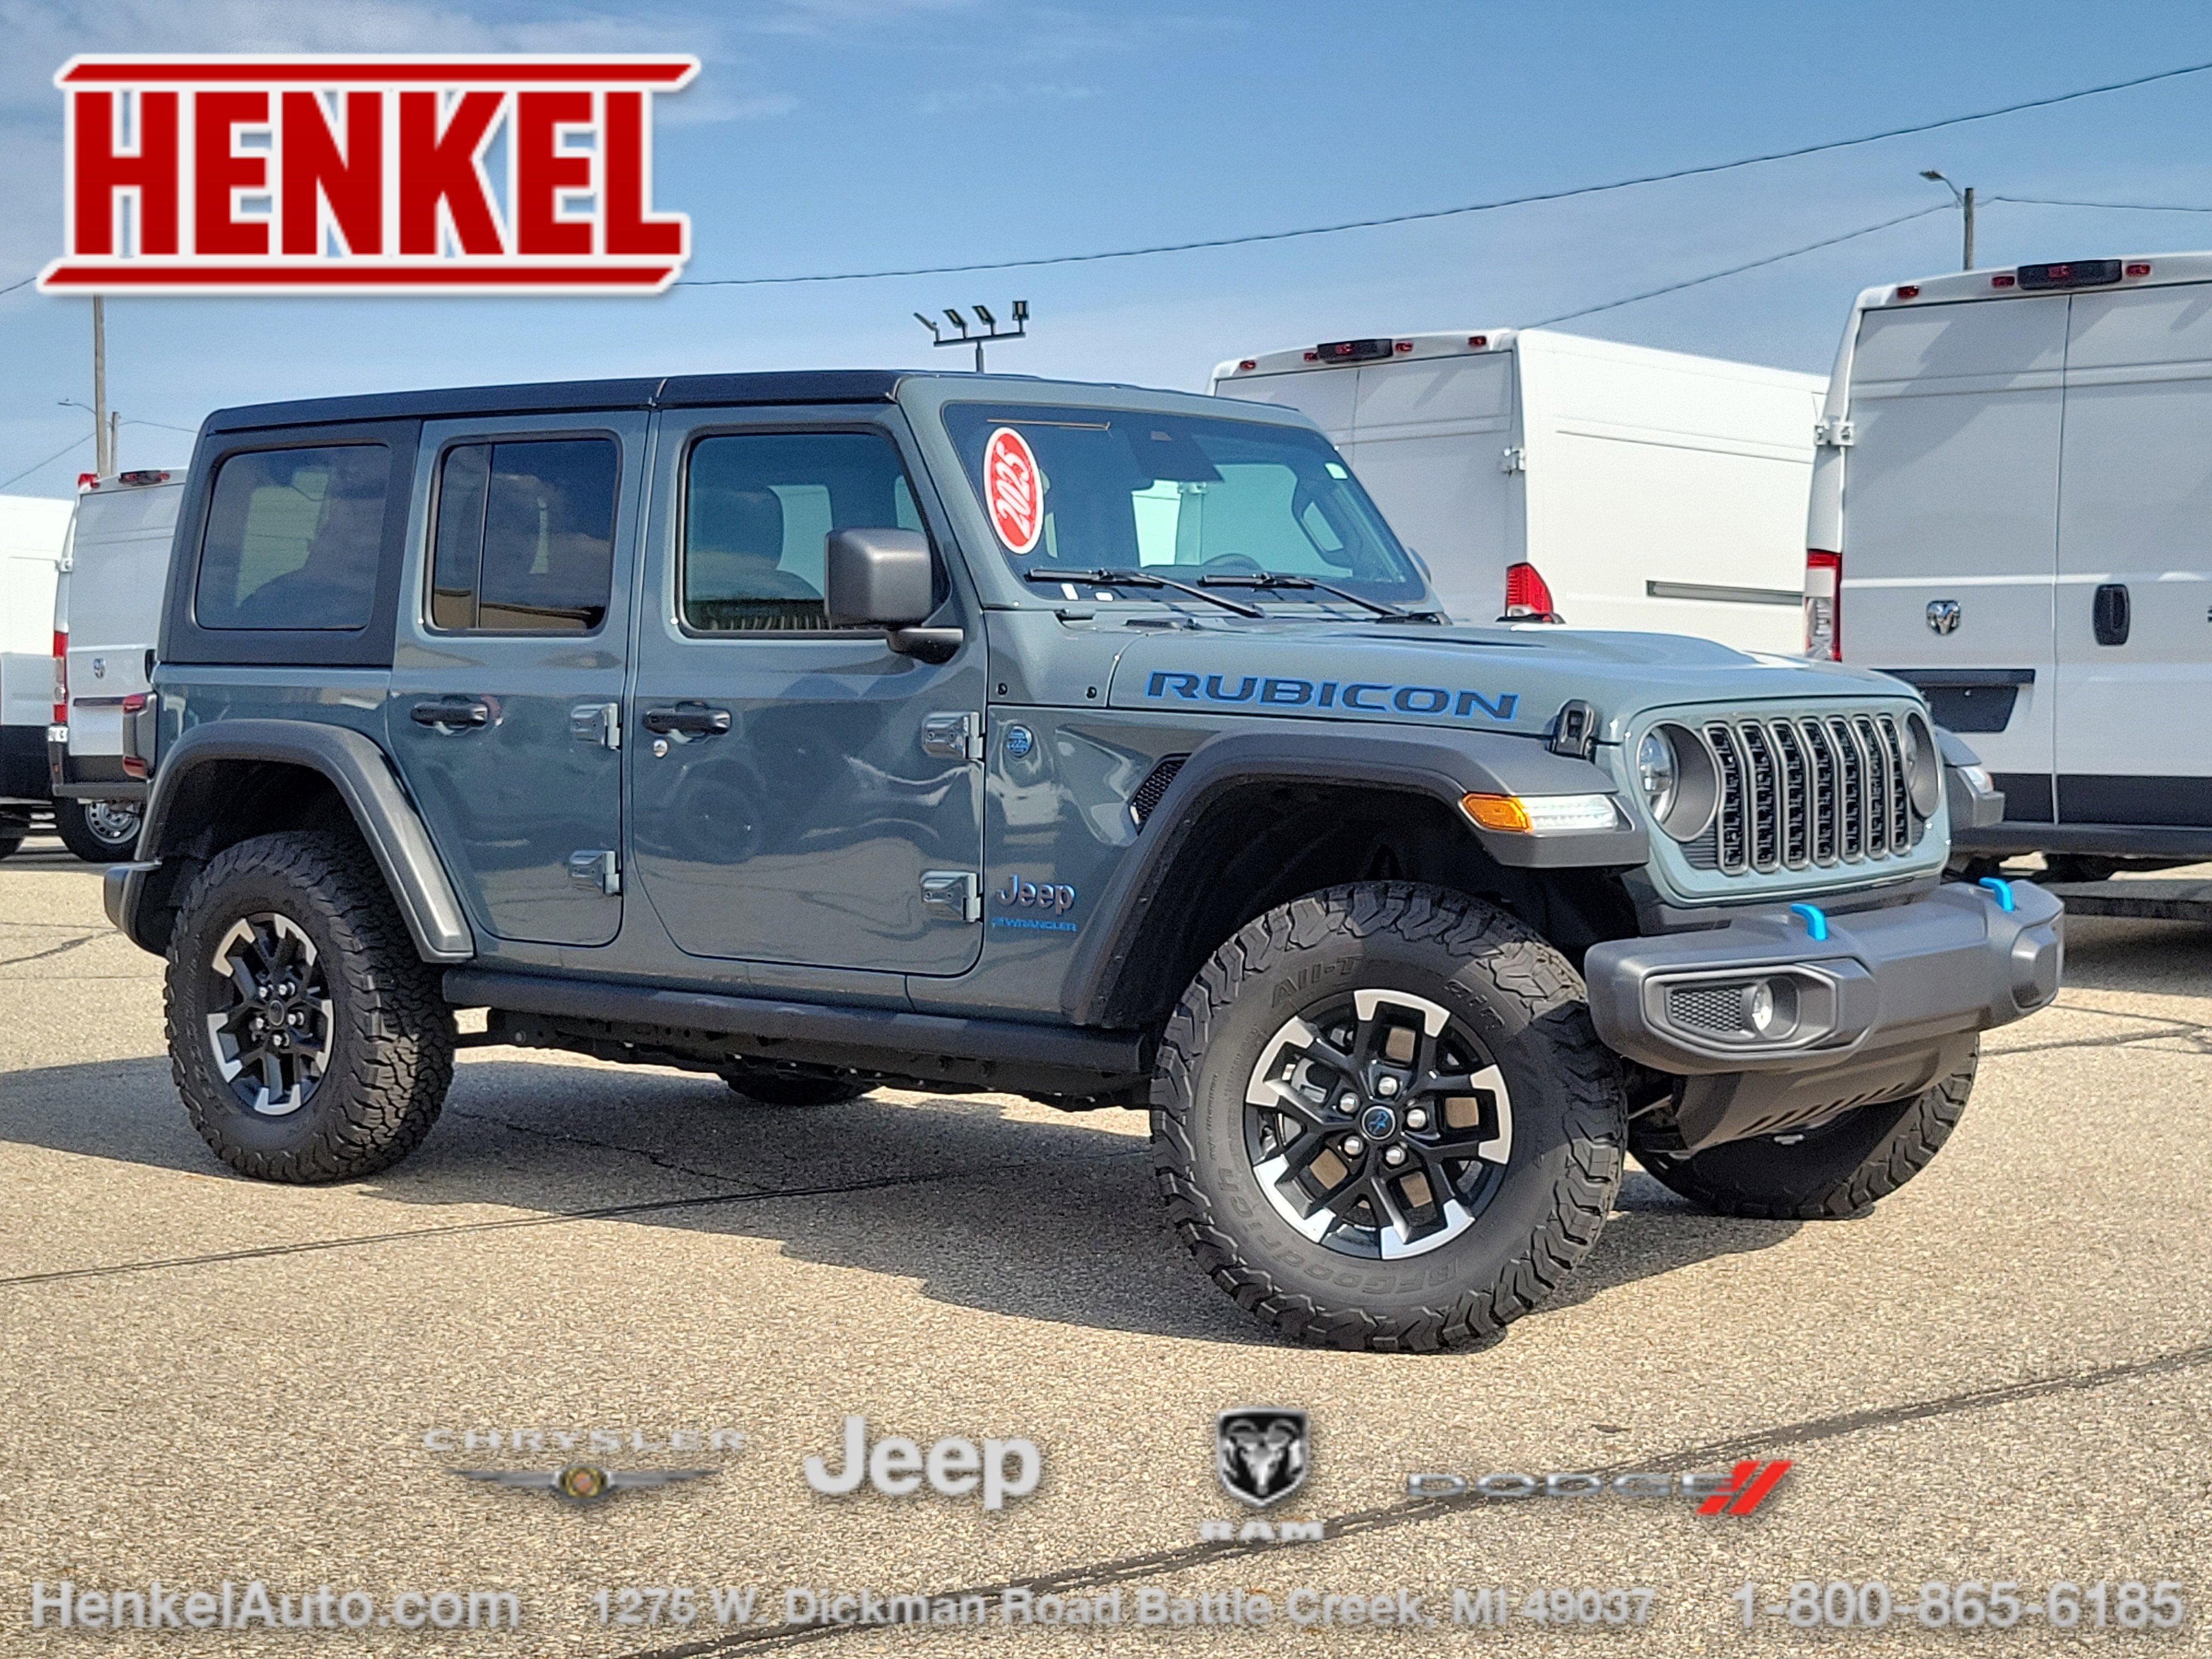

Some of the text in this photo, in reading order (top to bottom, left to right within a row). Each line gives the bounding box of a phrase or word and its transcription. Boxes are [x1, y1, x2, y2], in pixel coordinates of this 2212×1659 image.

[996, 441, 1031, 540] 2025
[1148, 670, 1519, 721] RUBICON
[997, 874, 1076, 915] Jeep
